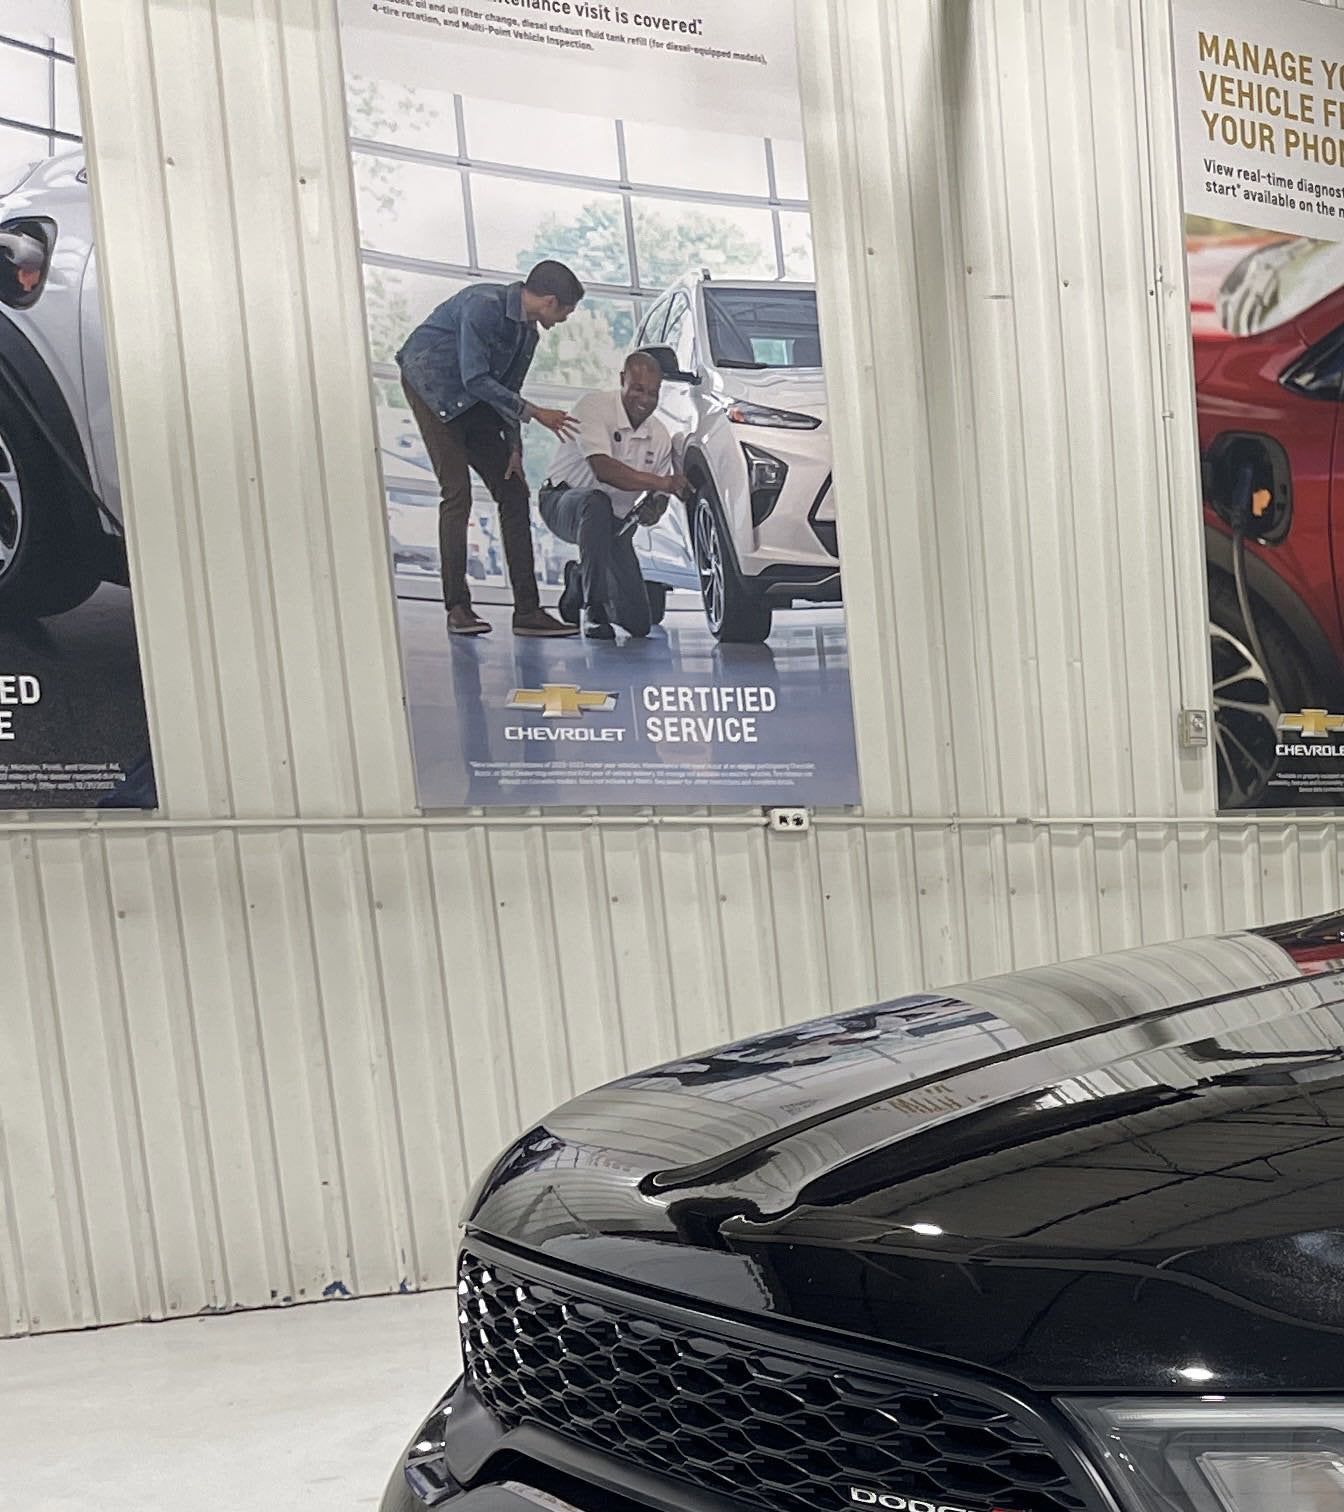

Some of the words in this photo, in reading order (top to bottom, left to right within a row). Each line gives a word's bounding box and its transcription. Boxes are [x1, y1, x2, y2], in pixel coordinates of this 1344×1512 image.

[372, 4, 399, 16] 4-tire
[402, 11, 442, 26] rotation,
[443, 19, 460, 28] and
[462, 21, 511, 37] Multi-Point
[512, 29, 545, 44] Vehicle
[546, 35, 594, 51] Inspection.
[575, 2, 611, 21] visit
[616, 7, 629, 24] is
[416, 1, 427, 9] oil
[429, 3, 445, 13] and
[448, 6, 459, 15] oil
[461, 8, 483, 19] filter
[485, 13, 520, 27] change,
[522, 19, 547, 30] diesel
[549, 24, 583, 37] exhaust
[585, 28, 605, 40] fluid
[606, 32, 625, 44] tank
[627, 36, 647, 47] refill
[649, 38, 664, 49] (for
[666, 41, 731, 60] diesel-equipped
[1198, 31, 1313, 86] MANAGE
[1198, 70, 1315, 124] VEHICLE
[1201, 110, 1276, 154] YOUR
[1203, 158, 1234, 178] View
[1237, 168, 1294, 190] real-time
[1243, 189, 1296, 209] available
[1299, 200, 1313, 213] on
[1316, 201, 1336, 217] the
[642, 686, 777, 712] CERTIFIED
[504, 726, 626, 742] CHEVROLET
[647, 717, 758, 743] SERVICE
